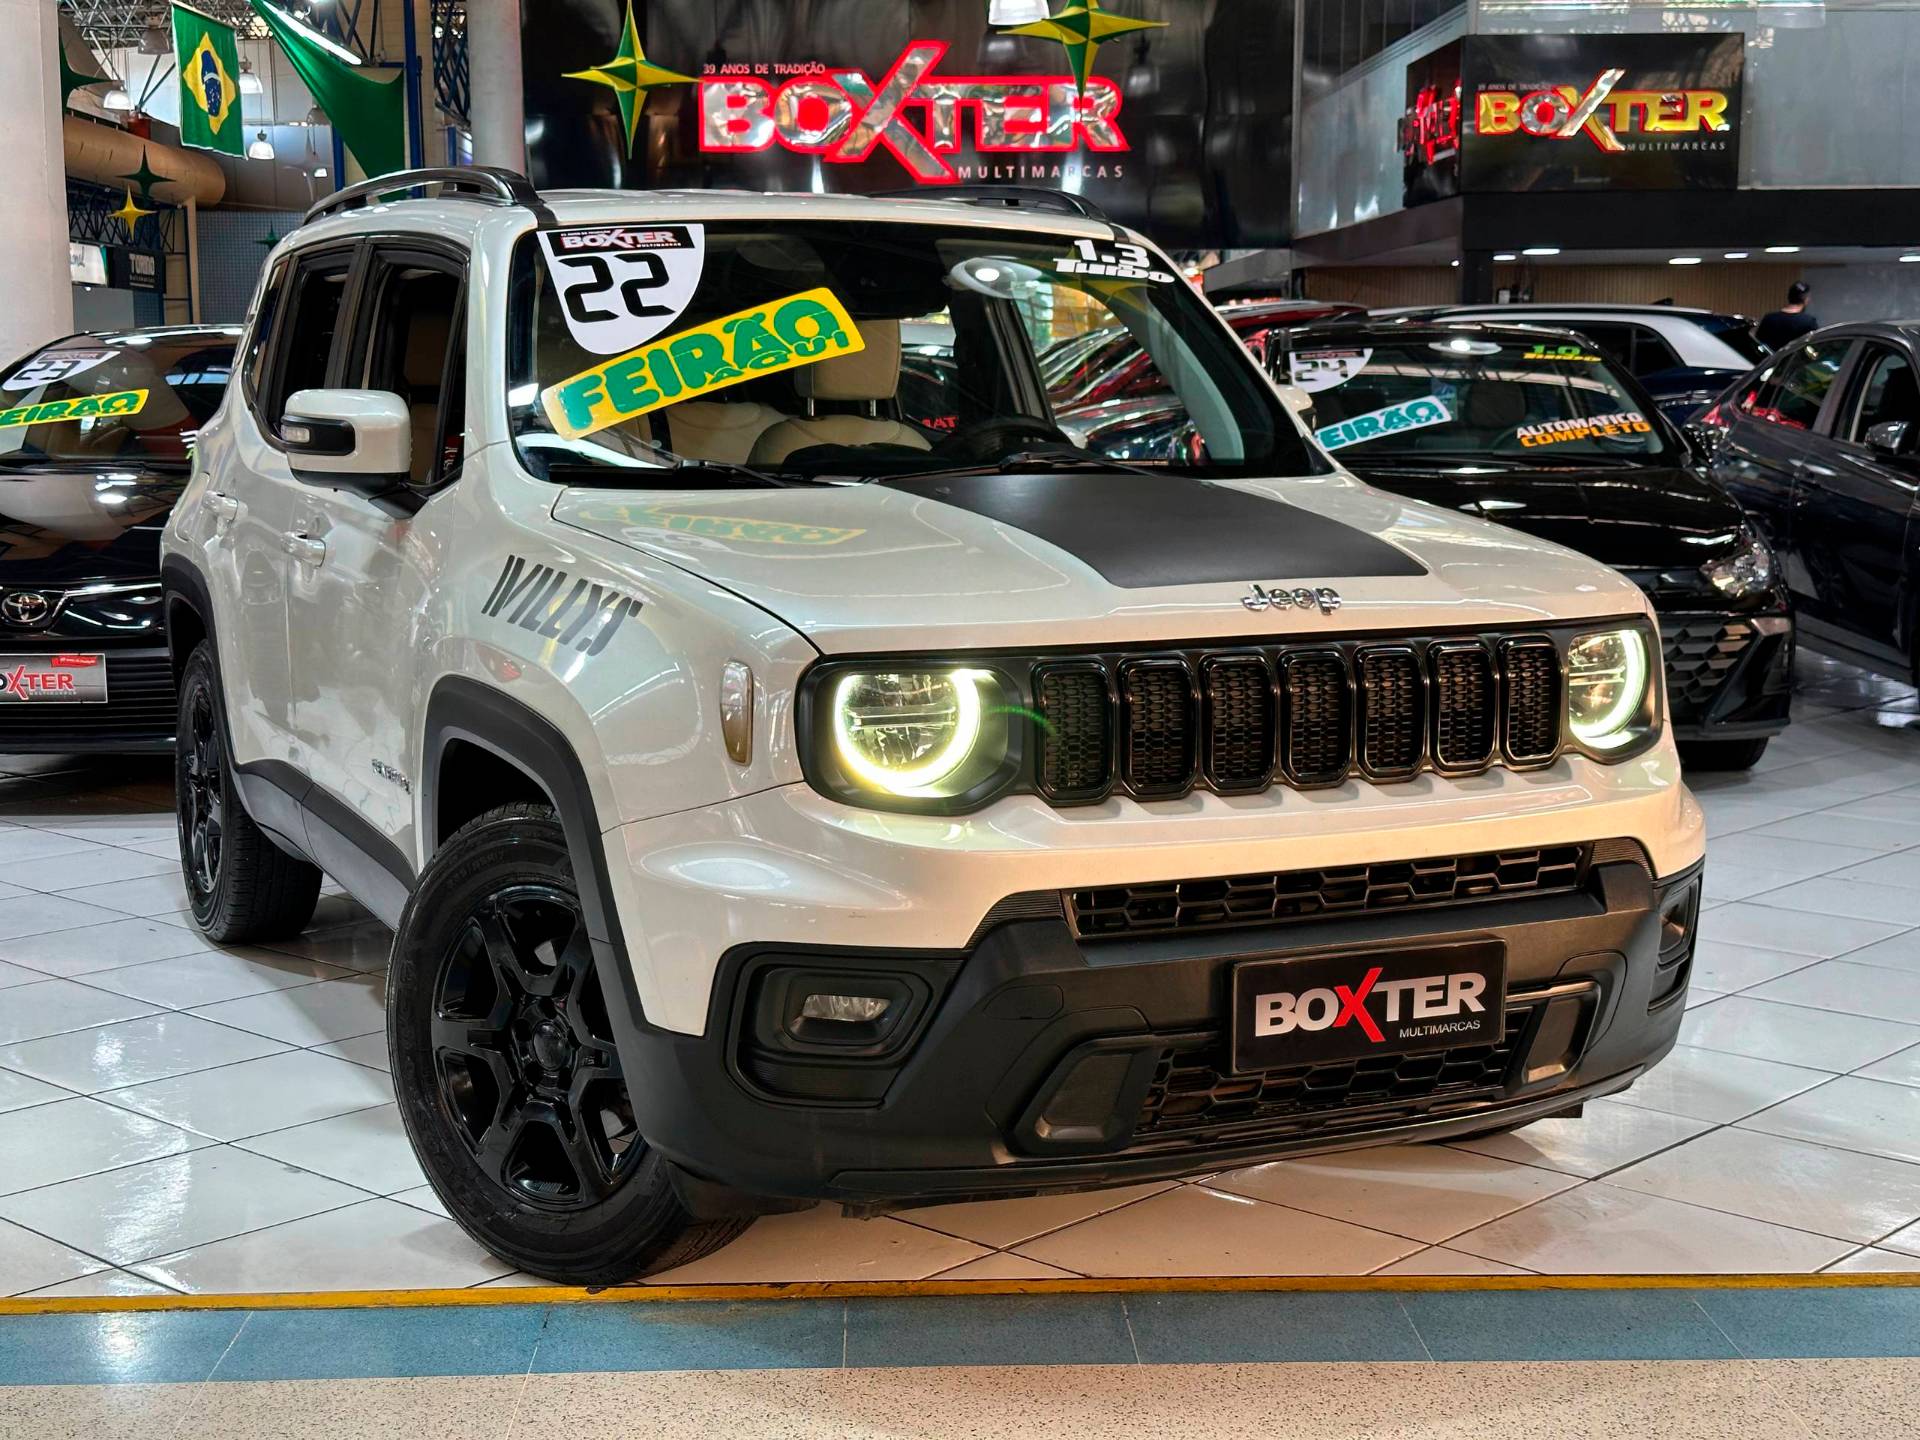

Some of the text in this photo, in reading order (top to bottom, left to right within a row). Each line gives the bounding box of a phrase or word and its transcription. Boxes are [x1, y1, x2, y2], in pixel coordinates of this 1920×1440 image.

[703, 61, 826, 76] 39 ANOS DE TRADIÇÃO
[700, 40, 1130, 184] BOXTER
[1475, 68, 1731, 152] BOXTER
[1626, 141, 1726, 151] MULTIMARCAS
[958, 165, 1124, 179] MULTIMARCAS
[560, 229, 678, 249] BOXTER
[1073, 239, 1150, 268] 1.3
[558, 252, 677, 323] 22
[13, 361, 82, 380] 23
[559, 299, 842, 431] FEIRÃO
[0, 392, 140, 426] EIRÃO
[1313, 401, 1440, 449] EIRÃO
[1516, 411, 1644, 439] AUTOMATICO
[1520, 421, 1652, 448] COMPLETO
[1241, 584, 1343, 616] Jeep
[1254, 966, 1487, 1043] BOXTER
[1399, 1019, 1481, 1039] MULTIMARCAS
